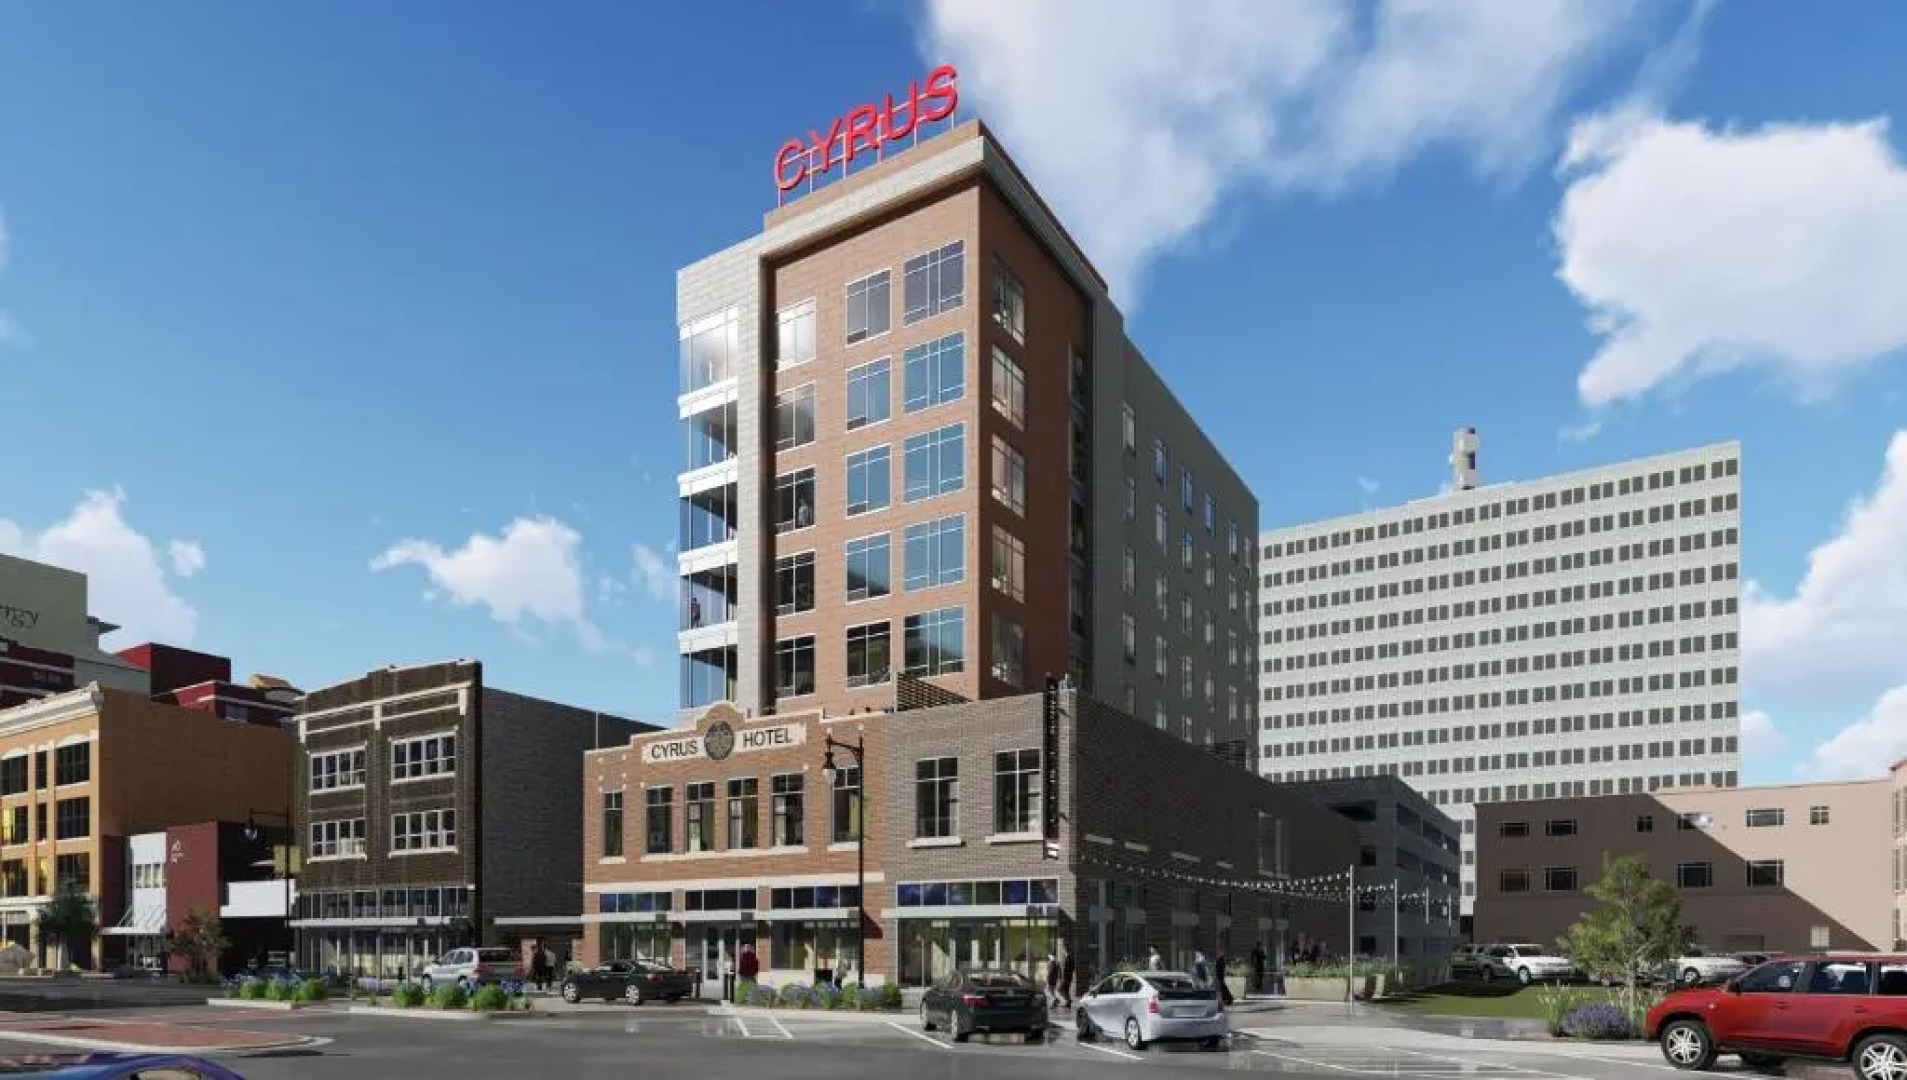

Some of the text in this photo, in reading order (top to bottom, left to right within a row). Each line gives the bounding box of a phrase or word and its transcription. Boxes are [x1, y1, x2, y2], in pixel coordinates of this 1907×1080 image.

[774, 64, 957, 190] CYRUS
[0, 604, 39, 628] rgy
[651, 727, 791, 760] CYRUS HOTEL
